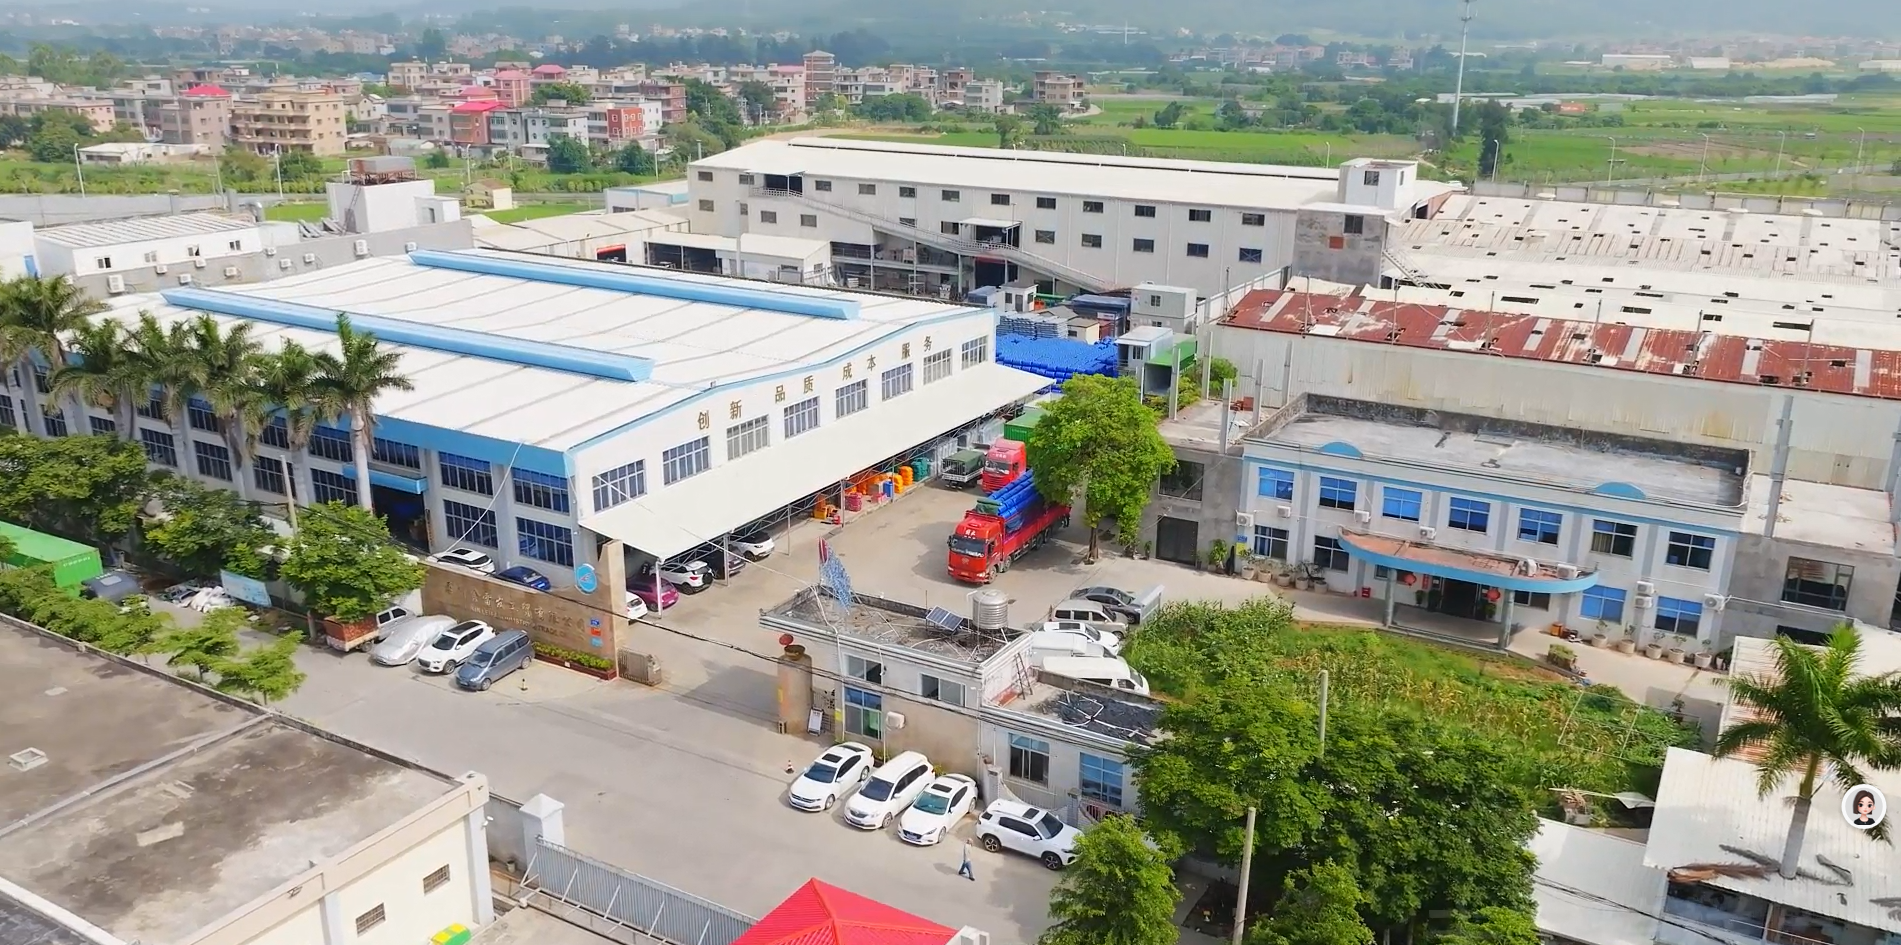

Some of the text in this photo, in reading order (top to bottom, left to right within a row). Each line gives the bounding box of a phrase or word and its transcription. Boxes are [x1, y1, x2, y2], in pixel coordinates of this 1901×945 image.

[697, 335, 932, 431] 创新 品质 成本 服务
